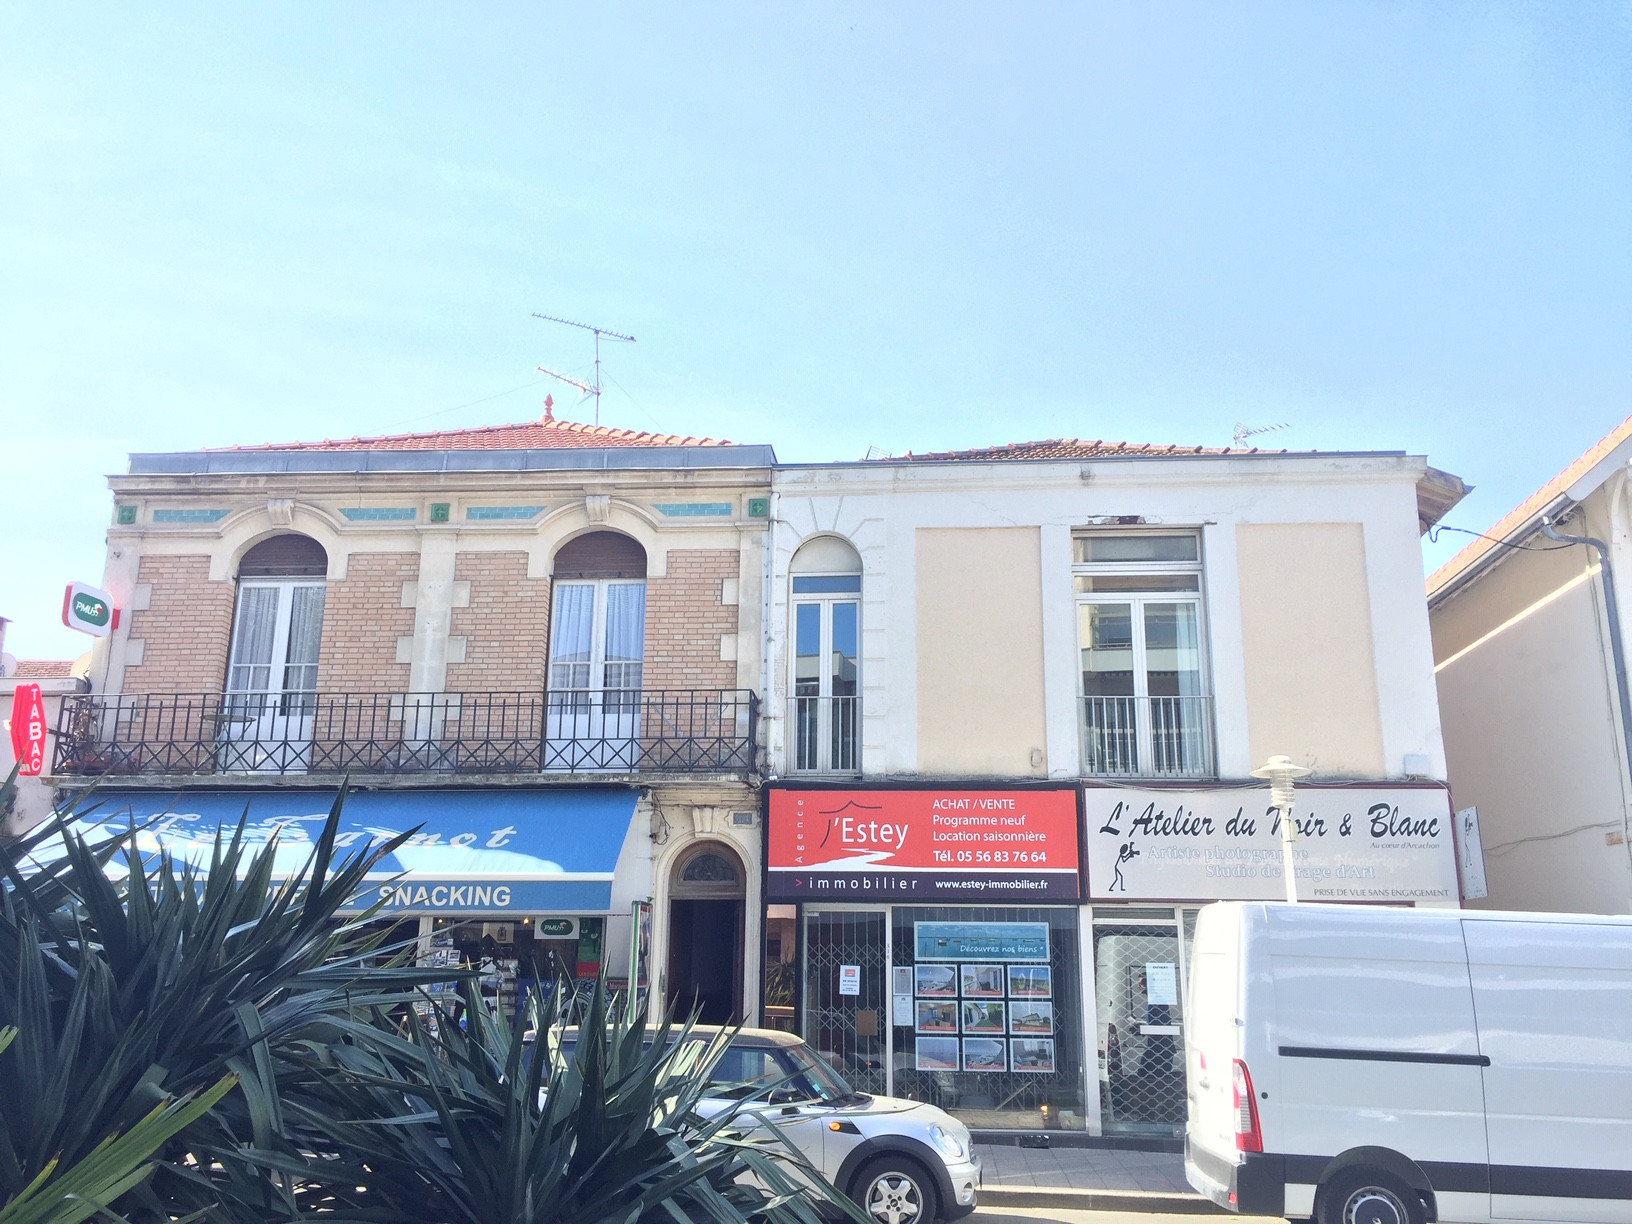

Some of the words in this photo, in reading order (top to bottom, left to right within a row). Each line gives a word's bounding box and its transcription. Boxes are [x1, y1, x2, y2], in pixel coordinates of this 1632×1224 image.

[76, 600, 93, 617] PMU
[29, 688, 42, 772] TABAC
[932, 799, 970, 810] ACHAT
[979, 799, 1016, 810] VENTE
[933, 815, 998, 828] Programme
[1000, 814, 1027, 826] neuf
[1099, 801, 1216, 838] L'Atelier
[1225, 806, 1257, 837] du
[1338, 812, 1352, 838] &
[1367, 802, 1441, 838] Blanc
[795, 799, 805, 864] Agence
[933, 830, 981, 842] Location
[983, 830, 1047, 842] saisonnière
[932, 850, 955, 862] Tél.
[957, 851, 973, 863] 05
[975, 851, 991, 863] 56
[993, 851, 1010, 863] 83
[1012, 851, 1028, 863] 76
[1030, 851, 1047, 863] 64
[1148, 846, 1201, 859] Artiste
[1205, 864, 1257, 878] Studio
[1261, 865, 1281, 878] de
[1288, 866, 1332, 882] rage
[1335, 865, 1376, 879] d'Art
[809, 876, 918, 890] immobilier
[935, 879, 1049, 891] www.estey-immobilier.fr
[377, 885, 511, 907] SNACKING
[1314, 888, 1336, 896] PRISE
[1391, 889, 1449, 897] ENGAGEMENT
[544, 923, 561, 932] PMU
[960, 944, 1000, 953] Découvrez
[1001, 946, 1016, 954] nos
[1017, 944, 1038, 953] biens
